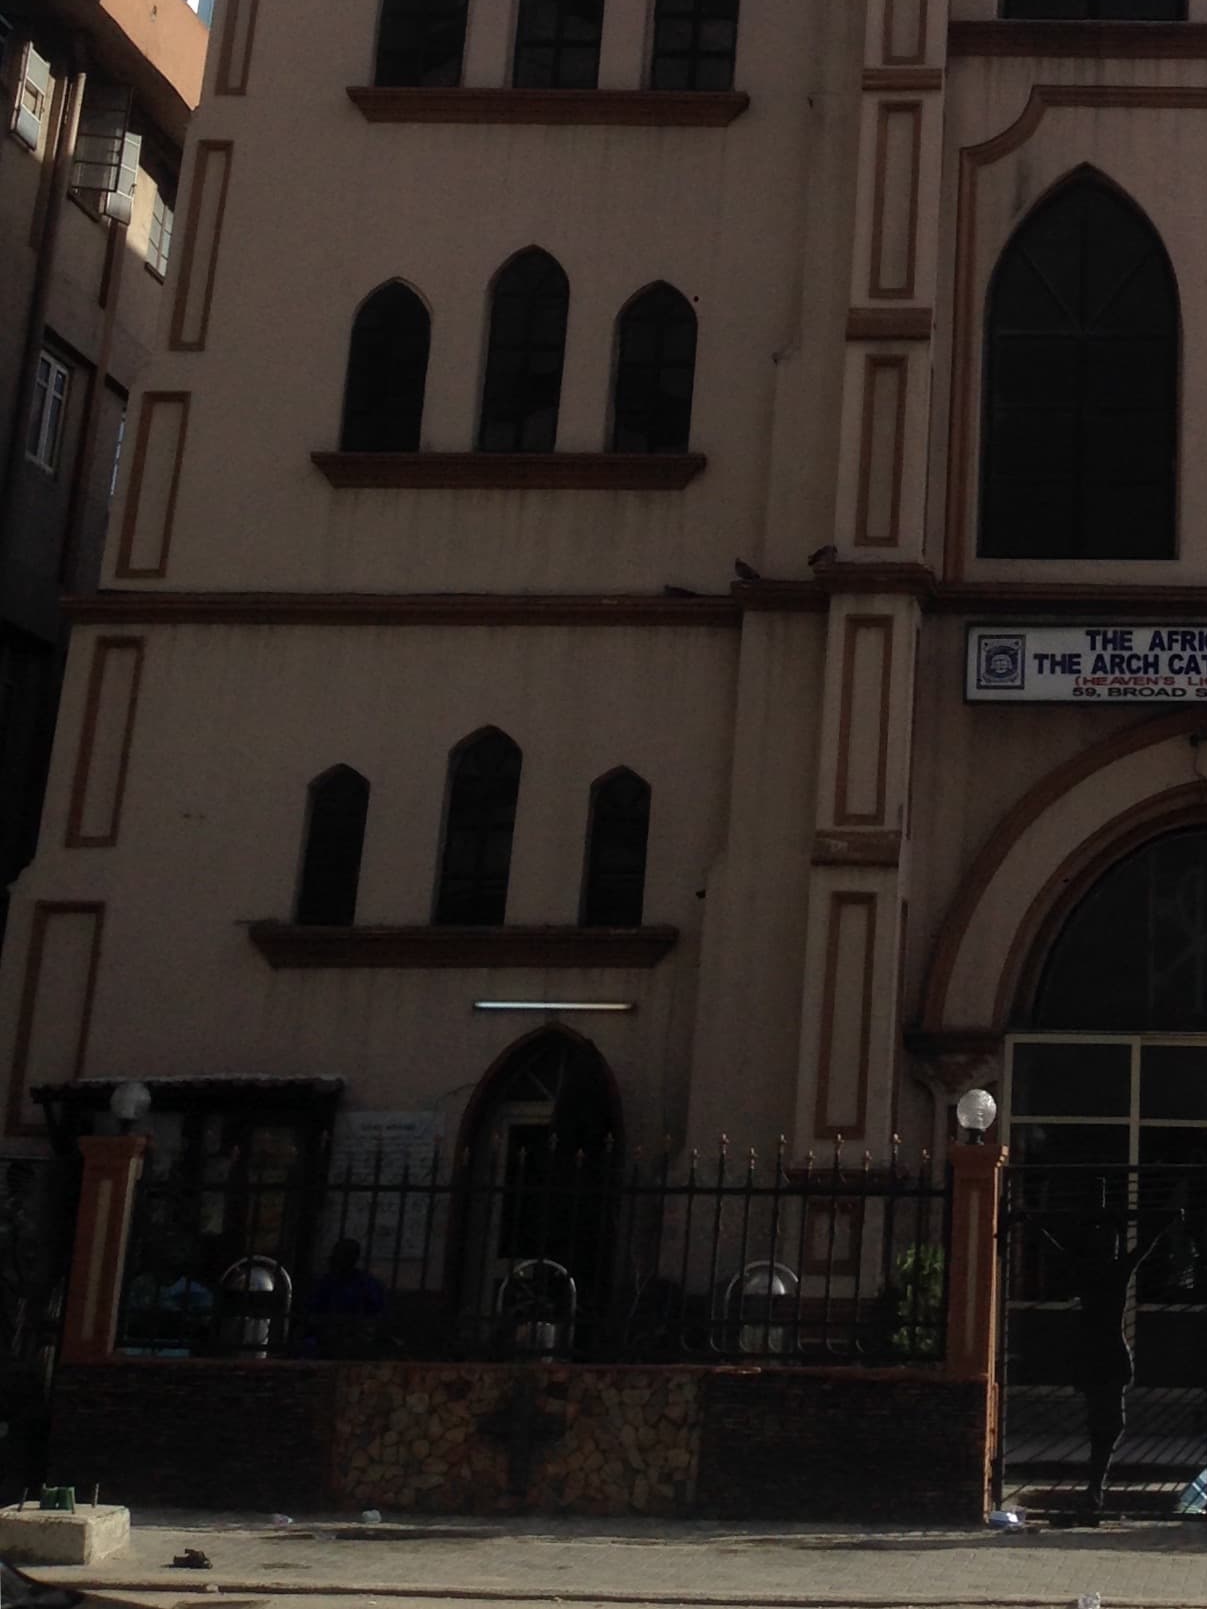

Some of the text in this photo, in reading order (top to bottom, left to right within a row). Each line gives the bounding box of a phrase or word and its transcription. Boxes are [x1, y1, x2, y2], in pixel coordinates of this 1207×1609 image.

[1086, 630, 1133, 652] THE
[1033, 654, 1081, 675] THE
[1092, 654, 1159, 676] ARCH
[1075, 676, 1175, 687] (HEAVEN'S
[1072, 687, 1102, 699] 59,
[1108, 687, 1187, 698] BROAD
